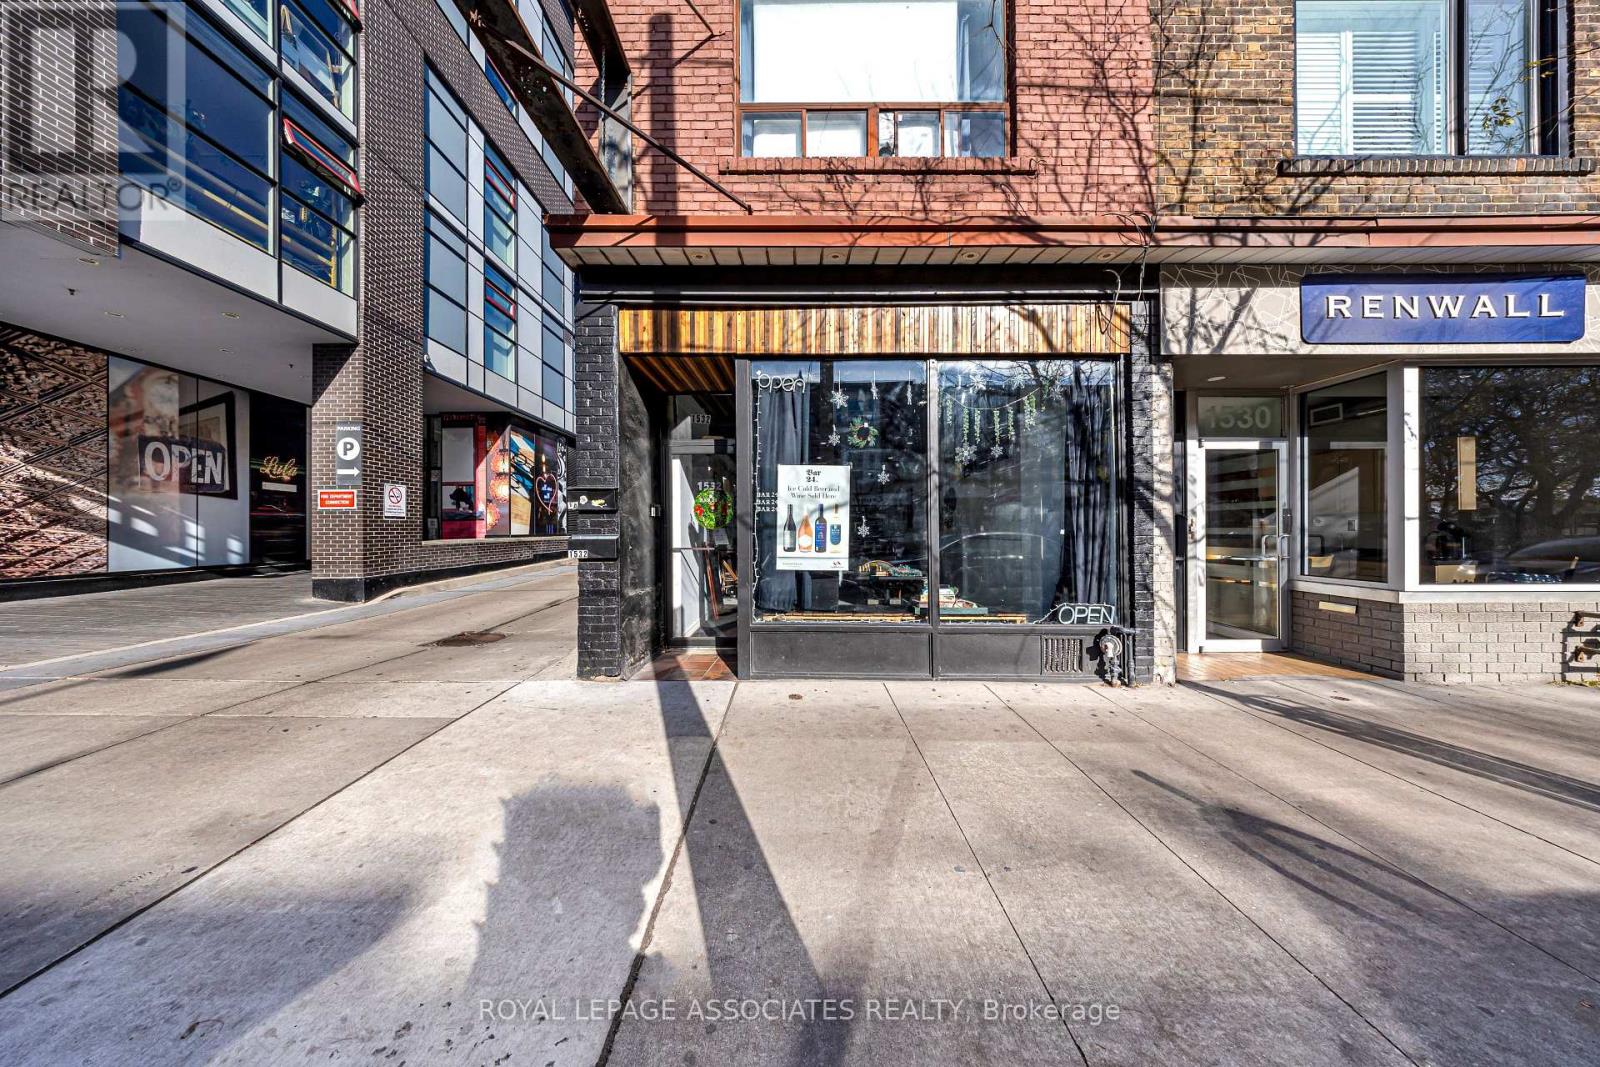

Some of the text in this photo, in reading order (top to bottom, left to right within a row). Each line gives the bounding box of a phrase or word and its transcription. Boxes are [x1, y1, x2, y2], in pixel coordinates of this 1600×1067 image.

[1325, 293, 1565, 319] RENWALL
[758, 373, 806, 393] open
[692, 414, 711, 424] 1532
[1205, 405, 1271, 429] 1530
[343, 442, 355, 456] P
[144, 441, 223, 484] OPEN
[697, 481, 722, 490] 1532
[569, 550, 588, 558] 1532
[1058, 606, 1115, 624] OPEN
